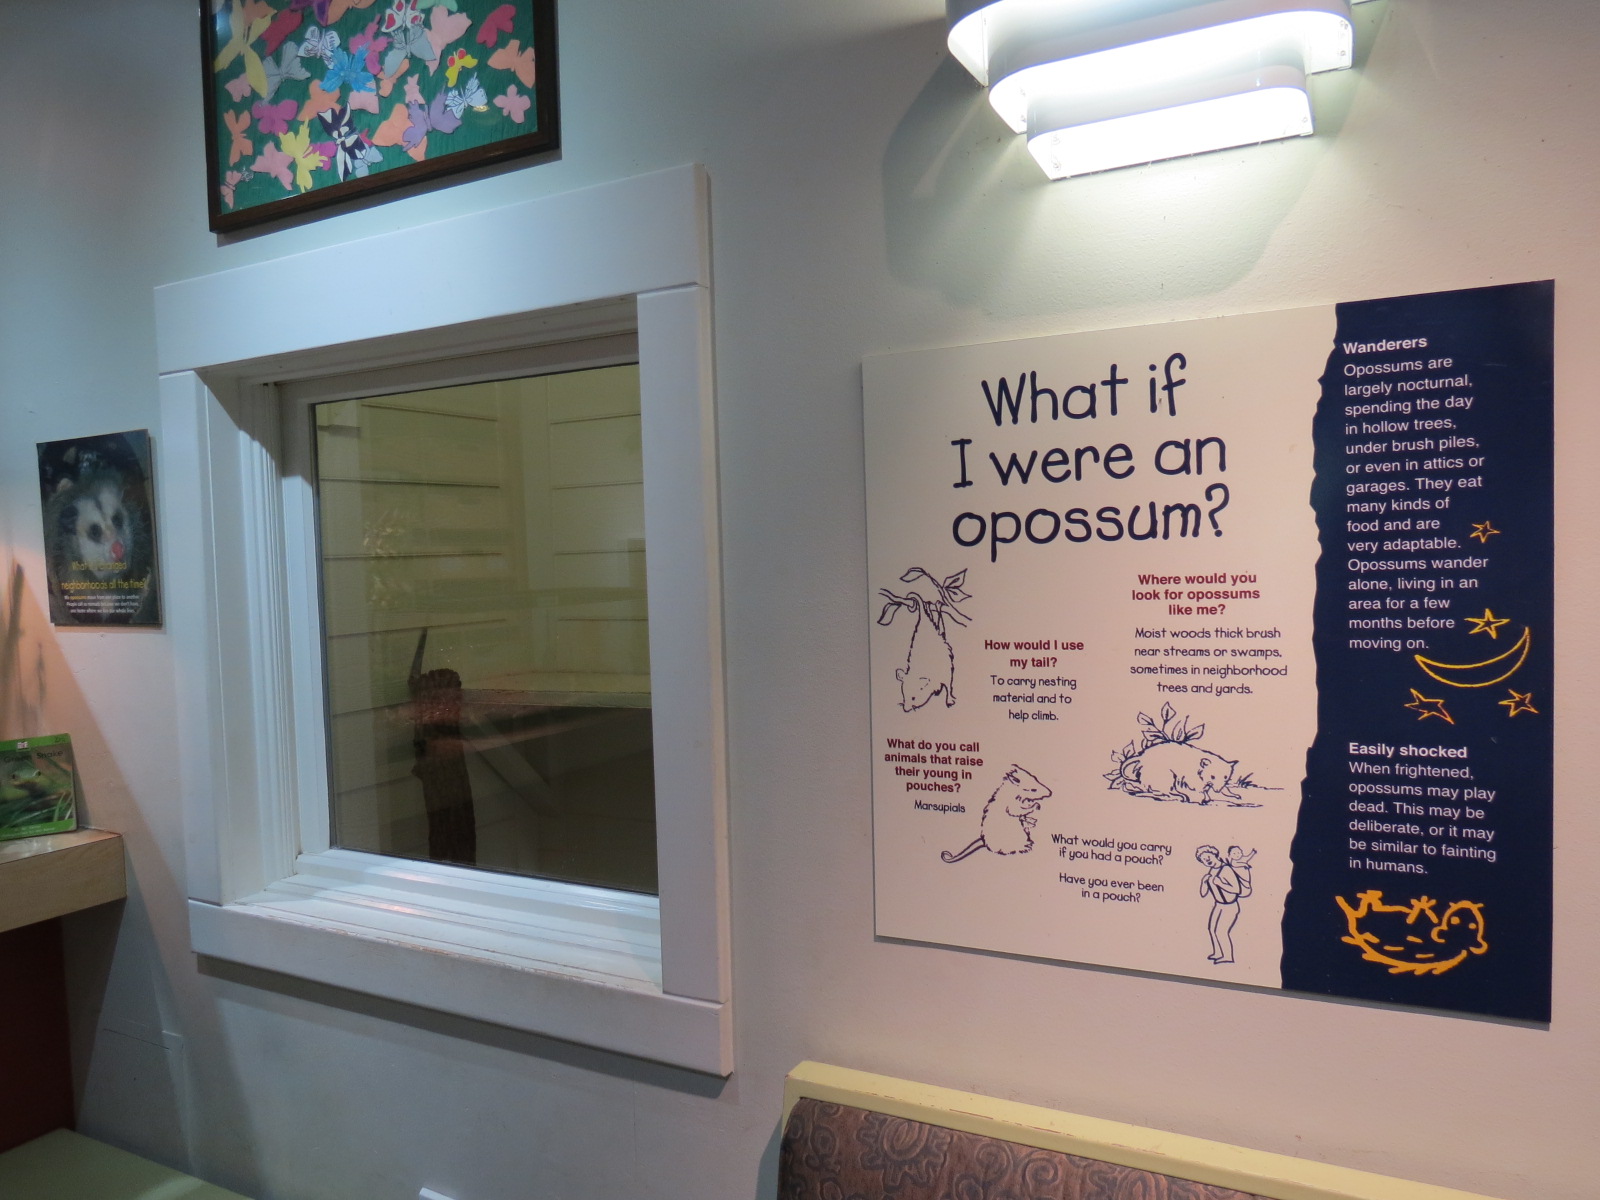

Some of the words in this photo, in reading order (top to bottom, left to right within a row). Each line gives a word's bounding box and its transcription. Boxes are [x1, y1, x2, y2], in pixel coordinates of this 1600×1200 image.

[1343, 337, 1427, 354] Wanderers
[1344, 358, 1422, 378] Opossums
[1427, 356, 1452, 369] are
[981, 364, 1128, 426] What
[1148, 353, 1187, 416] if
[1345, 382, 1392, 397] largely
[1397, 374, 1472, 392] nocturnal,
[1345, 401, 1411, 417] spending
[1416, 398, 1439, 410] the
[1445, 396, 1473, 409] day
[1345, 424, 1357, 434] in
[1363, 420, 1409, 433] hollow
[1414, 418, 1456, 430] trees,
[1346, 442, 1387, 454] under
[1392, 438, 1433, 451] brush
[1439, 436, 1479, 451] piles,
[951, 439, 973, 488] I
[989, 444, 1135, 486] were
[1155, 437, 1226, 475] an
[1346, 464, 1360, 473] or
[1365, 461, 1400, 472] even
[1406, 459, 1418, 470] in
[1423, 457, 1463, 469] attics
[1469, 457, 1484, 467] or
[1346, 481, 1409, 496] garages.
[1415, 478, 1452, 491] They
[1457, 476, 1482, 488] eat
[1347, 502, 1386, 514] many
[1391, 498, 1430, 510] kinds
[1435, 497, 1449, 509] of
[953, 482, 1230, 562] opossum?
[1347, 520, 1378, 532] food
[1384, 519, 1410, 531] and
[1416, 520, 1440, 529] are
[1348, 541, 1378, 553] very
[1383, 537, 1460, 552] adaptable.
[1348, 558, 1426, 573] Opossums
[1431, 556, 1488, 569] wander
[118, 578, 129, 589] the
[1138, 575, 1181, 585] Where
[1185, 573, 1226, 584] would
[1231, 575, 1256, 586] you
[1348, 578, 1391, 591] alone,
[1397, 578, 1435, 591] living
[1441, 577, 1453, 588] in
[1459, 579, 1477, 588] an
[1132, 590, 1160, 600] look
[1164, 589, 1183, 600] for
[1187, 590, 1260, 602] opossums
[1349, 599, 1381, 609] area
[1386, 597, 1405, 609] for
[1410, 599, 1419, 608] a
[1424, 597, 1450, 608] few
[1169, 605, 1192, 615] like
[1197, 604, 1225, 615] me?
[1349, 617, 1402, 629] months
[1407, 616, 1454, 629] before
[1135, 628, 1166, 638] Moist
[1170, 628, 1211, 638] woods
[1215, 627, 1243, 638] thick
[1246, 627, 1280, 638] brush
[985, 640, 1010, 650] How
[1014, 640, 1050, 650] would
[1054, 640, 1058, 650] I
[1062, 642, 1084, 650] use
[1349, 637, 1401, 651] moving
[1407, 638, 1428, 649] on.
[1164, 646, 1210, 656] streams
[1213, 647, 1227, 657] or
[1231, 649, 1282, 659] swamps.
[1010, 659, 1027, 669] my
[1031, 657, 1057, 667] tail?
[1131, 664, 1188, 674] sometimes
[1191, 664, 1200, 675] in
[1203, 664, 1287, 679] neighborhood
[991, 675, 1004, 685] To
[1007, 679, 1036, 689] carry
[1039, 676, 1076, 690] nesting
[1157, 682, 1188, 692] trees
[1191, 683, 1212, 693] and
[1216, 683, 1252, 696] yards.
[993, 693, 1034, 702] material
[1037, 694, 1056, 703] and
[1059, 693, 1072, 704] to
[1009, 709, 1029, 722] help
[1032, 710, 1058, 720] climb.
[887, 739, 914, 749] What
[918, 739, 932, 752] do
[935, 743, 956, 752] you
[960, 742, 979, 752] call
[1349, 743, 1394, 757] Easily
[1400, 745, 1467, 758] shocked
[37, 749, 64, 759] Snake
[885, 753, 926, 763] animals
[930, 754, 951, 764] that
[955, 756, 983, 766] raise
[895, 766, 920, 776] their
[923, 770, 958, 781] young
[961, 768, 972, 780] in
[1349, 762, 1390, 774] When
[1395, 764, 1473, 779] frightened,
[907, 782, 960, 792] pouches?
[1349, 783, 1422, 798] opossums
[1428, 787, 1459, 800] may
[1464, 787, 1495, 802] play
[914, 800, 965, 814] Marsupials
[1349, 800, 1387, 813] dead.
[1393, 802, 1424, 815] This
[1429, 807, 1460, 820] may
[1465, 807, 1484, 819] be
[1349, 819, 1423, 836] deliberate,
[1429, 825, 1444, 835] or
[1448, 824, 1457, 836] it
[1463, 827, 1494, 842] may
[1051, 834, 1078, 845] What
[1082, 838, 1114, 848] would
[1117, 842, 1137, 852] you
[1140, 844, 1171, 855] carry
[1349, 838, 1366, 850] be
[1371, 840, 1418, 854] similar
[1423, 842, 1436, 855] to
[1441, 844, 1496, 862] fainting
[1059, 846, 1067, 859] if
[1069, 851, 1088, 860] you
[1091, 850, 1111, 861] had
[1115, 853, 1122, 863] a
[1125, 851, 1164, 866] pouch?
[1349, 857, 1361, 868] in
[1366, 858, 1427, 873] humans.
[1060, 873, 1085, 884] Have
[1088, 879, 1108, 888] you
[1138, 880, 1164, 891] been
[1082, 888, 1091, 898] in
[1093, 890, 1100, 900] a
[1103, 889, 1141, 903] pouch?
